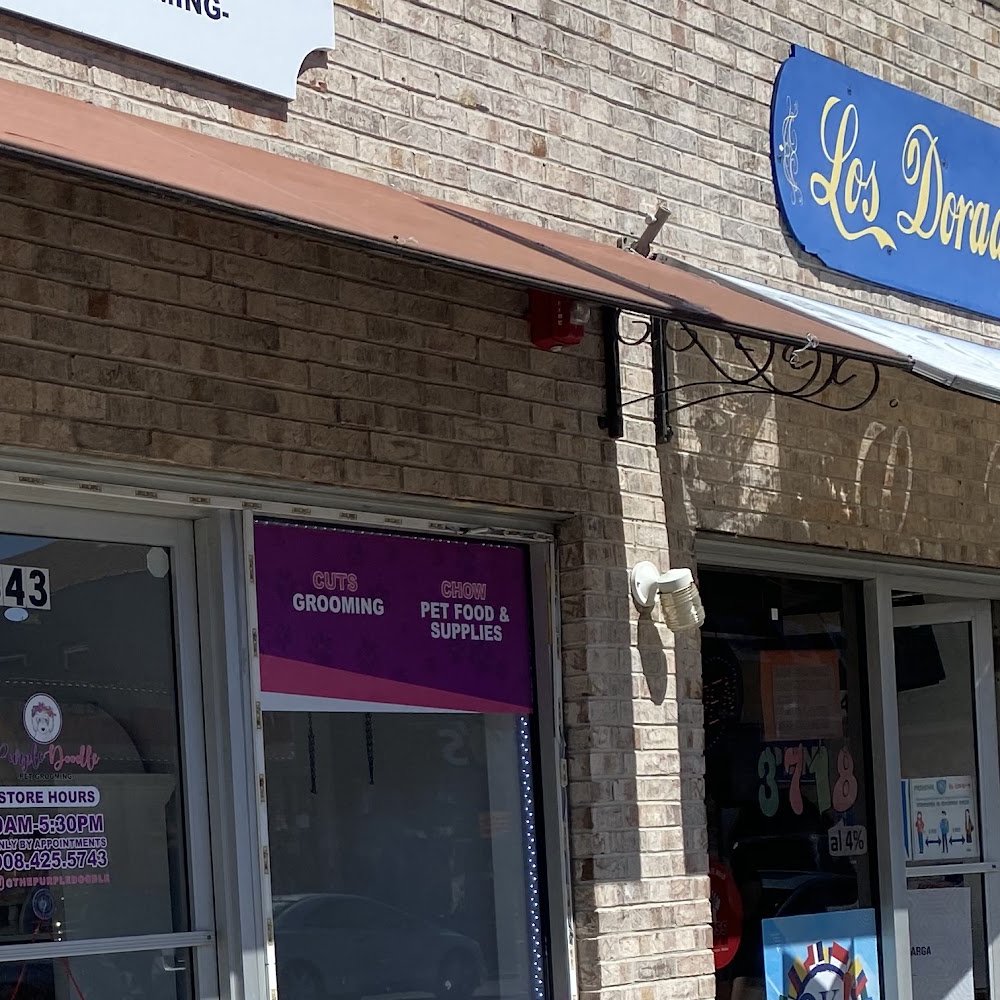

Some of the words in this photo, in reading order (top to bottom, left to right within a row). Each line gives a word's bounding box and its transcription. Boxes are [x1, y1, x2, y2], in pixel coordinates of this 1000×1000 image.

[810, 96, 897, 251] Los
[312, 570, 358, 592] CUTS
[441, 580, 487, 600] CHOW
[292, 593, 385, 616] GROOMING
[420, 601, 449, 619] PET
[454, 602, 495, 622] FOOD
[499, 606, 510, 622] &
[430, 621, 503, 641] SUPPLIES
[42, 744, 100, 772] Doodle
[48, 790, 96, 803] HOURS
[19, 837, 33, 851] BY
[34, 836, 107, 850] APPOINTMENTS
[830, 833, 842, 852] al
[845, 830, 864, 849] 4%
